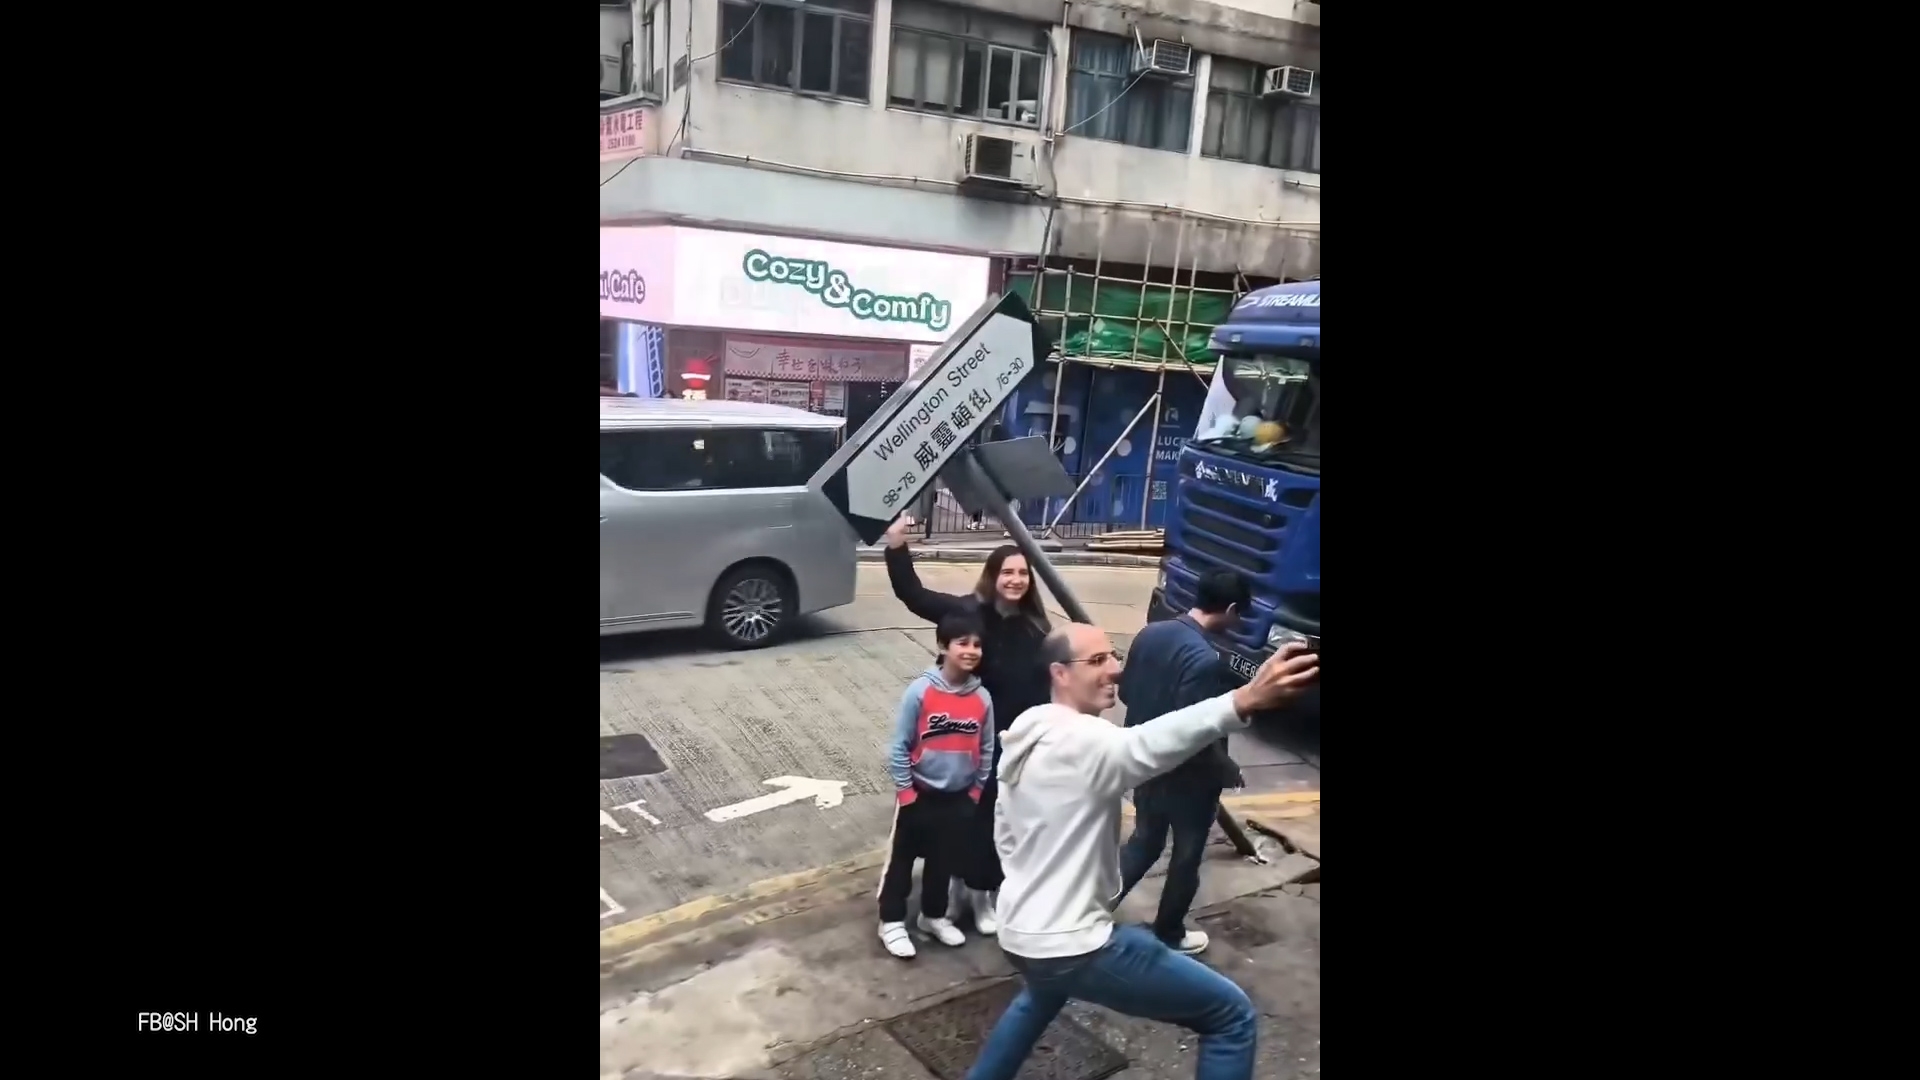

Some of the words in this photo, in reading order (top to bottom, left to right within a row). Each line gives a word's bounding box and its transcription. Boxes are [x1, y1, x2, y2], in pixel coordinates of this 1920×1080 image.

[610, 269, 645, 304] Cafe
[743, 248, 830, 290] Cozy
[821, 269, 854, 308] &
[850, 287, 952, 332] Comfy
[874, 387, 949, 461] Wellington
[947, 341, 991, 388] Street
[913, 388, 992, 472] 威靈頓街
